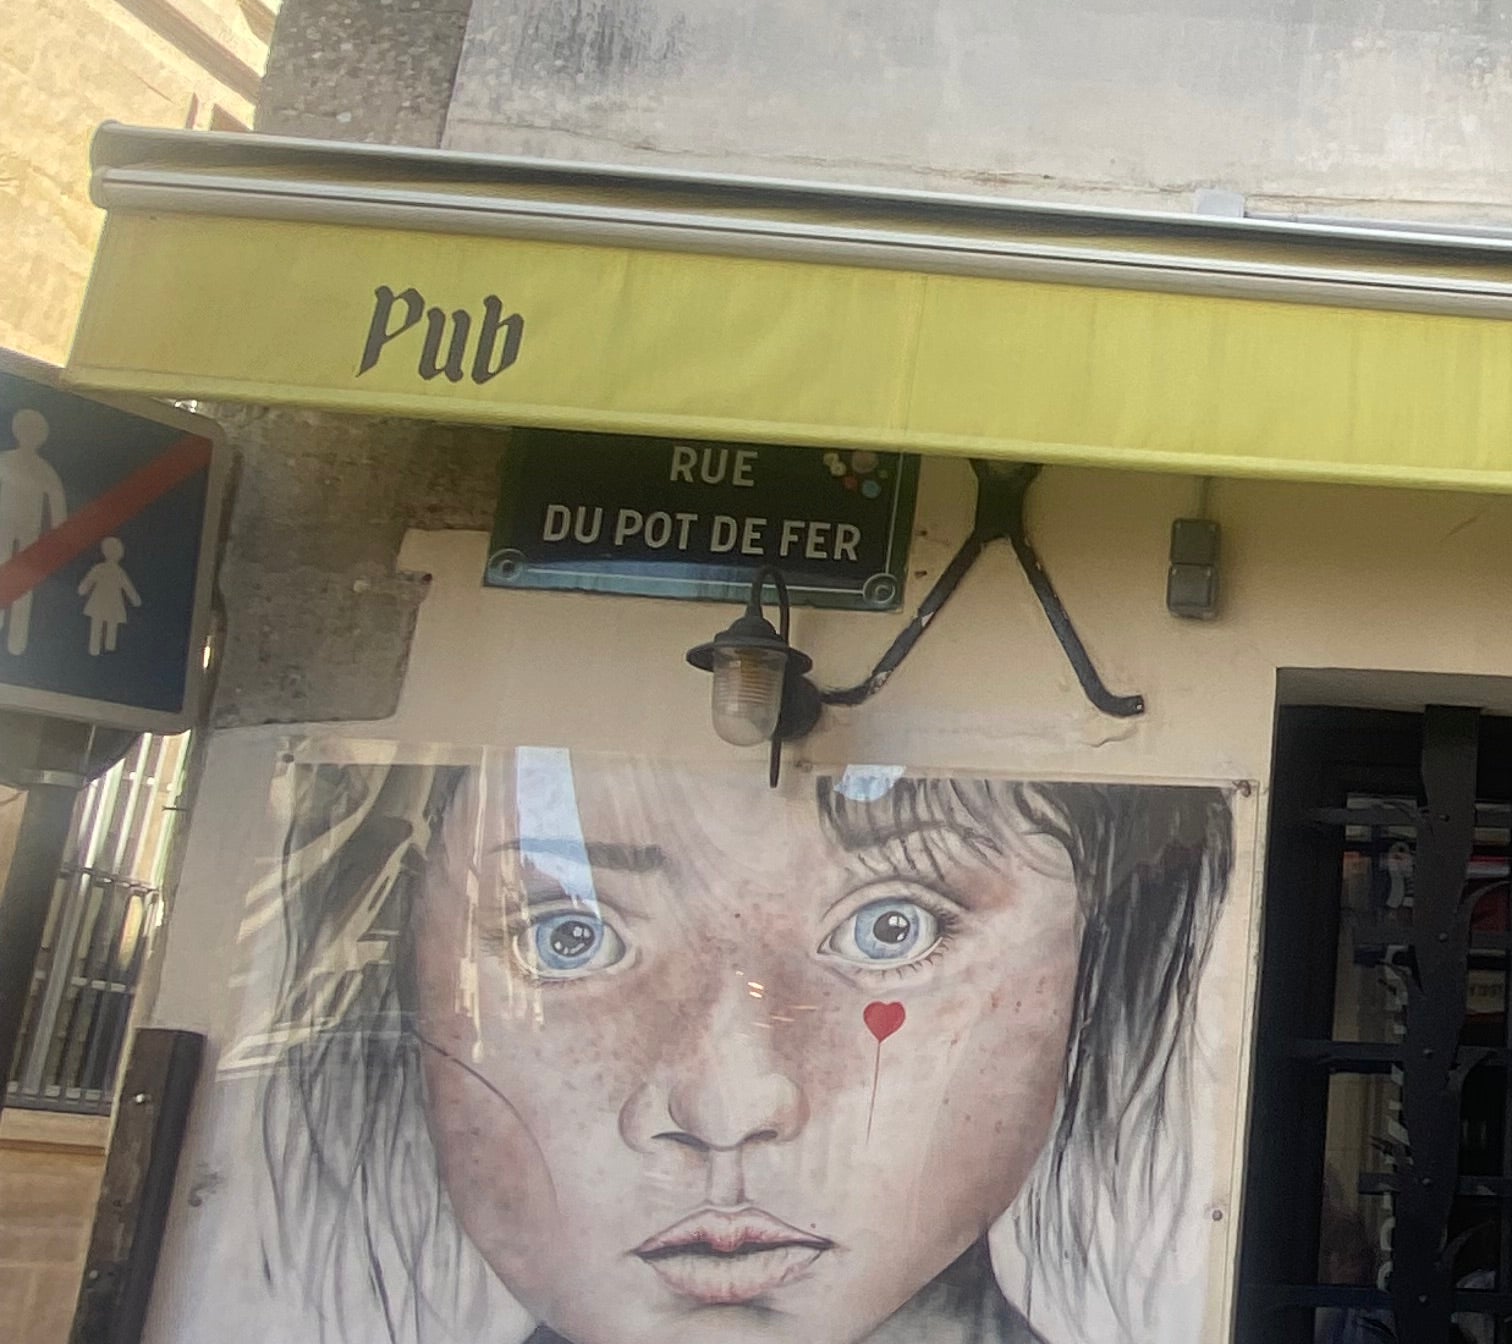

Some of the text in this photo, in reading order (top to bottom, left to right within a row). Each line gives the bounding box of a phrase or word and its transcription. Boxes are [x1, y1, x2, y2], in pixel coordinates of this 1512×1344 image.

[354, 285, 524, 384] Pub
[670, 446, 759, 487] RUE
[543, 504, 862, 561] DU POT DE FER
